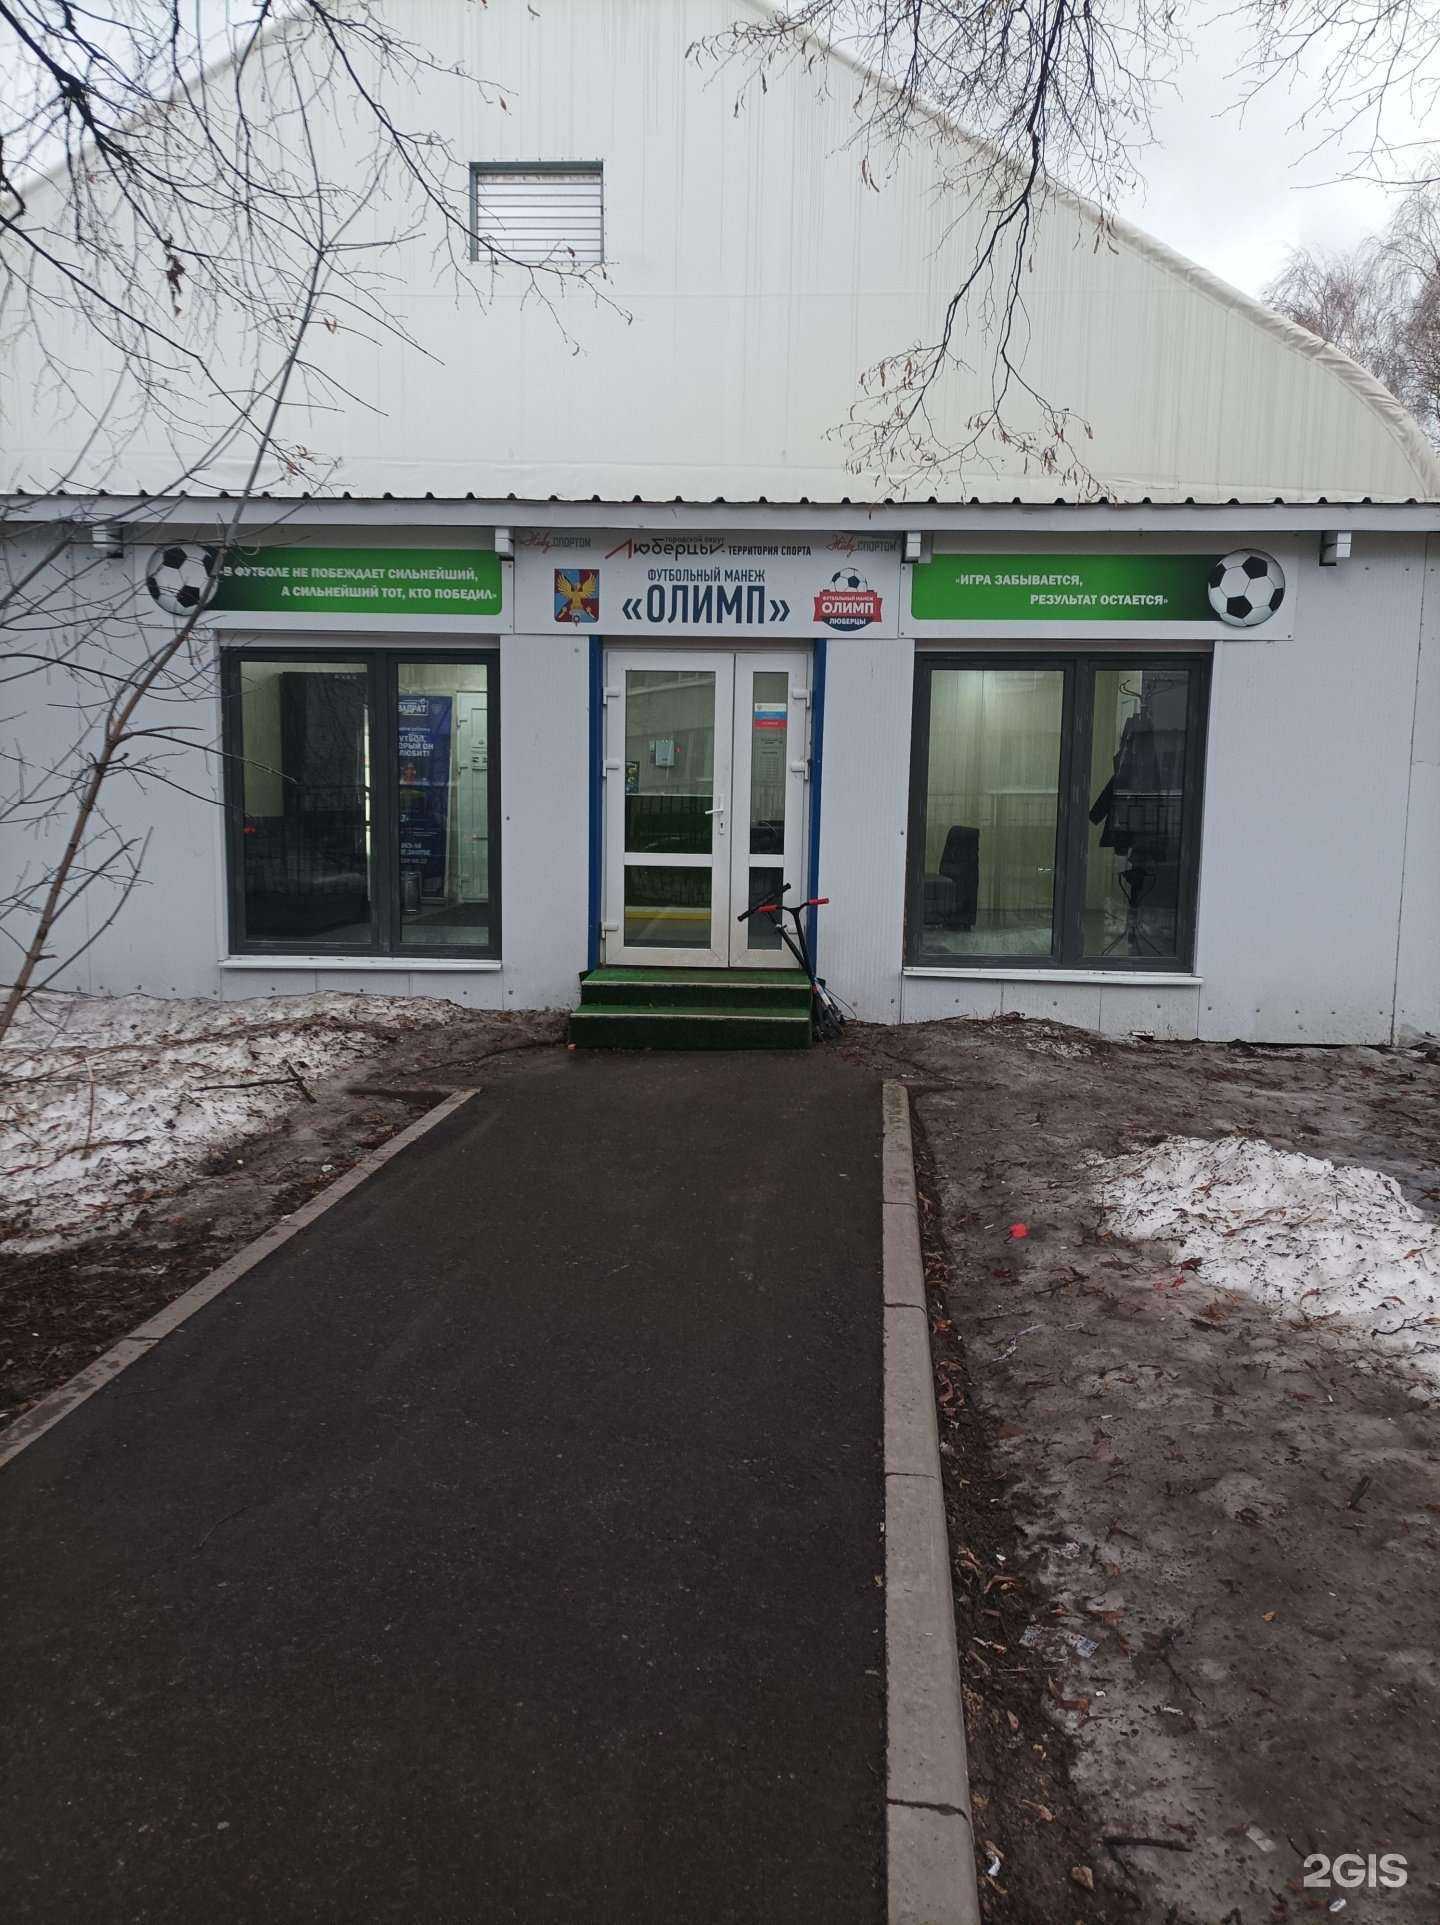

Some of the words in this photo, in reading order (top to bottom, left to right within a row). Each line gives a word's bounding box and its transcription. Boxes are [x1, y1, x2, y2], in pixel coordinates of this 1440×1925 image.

[604, 538, 724, 561] Люберцы
[728, 545, 779, 557] ТЕРРИТОРИЯ
[781, 545, 812, 557] СПОРТА
[234, 566, 290, 578] ФУТБОЛЕ
[292, 567, 309, 578] НЕ
[311, 567, 385, 580] ПОБЕЖДАЕТ
[388, 567, 479, 582] СИЛЬНЕЙШИЙ,
[647, 567, 721, 583] ФУТБОЛЬНЫЙ
[724, 569, 766, 583] МАНЕЖ
[995, 574, 1083, 587] ЗАБЫВАЕТСЯ,
[281, 585, 291, 597] А
[292, 585, 379, 598] СИЛЬНЕЙШИЙ
[381, 587, 406, 600] ТОТ,
[408, 588, 432, 599] КТО
[1029, 594, 1098, 605] РЕЗУЛЬТАТ
[621, 584, 791, 625] «ОЛИМП»
[821, 601, 874, 614] ОЛИМП
[828, 617, 867, 626] ЛЮБЕРЦЫ
